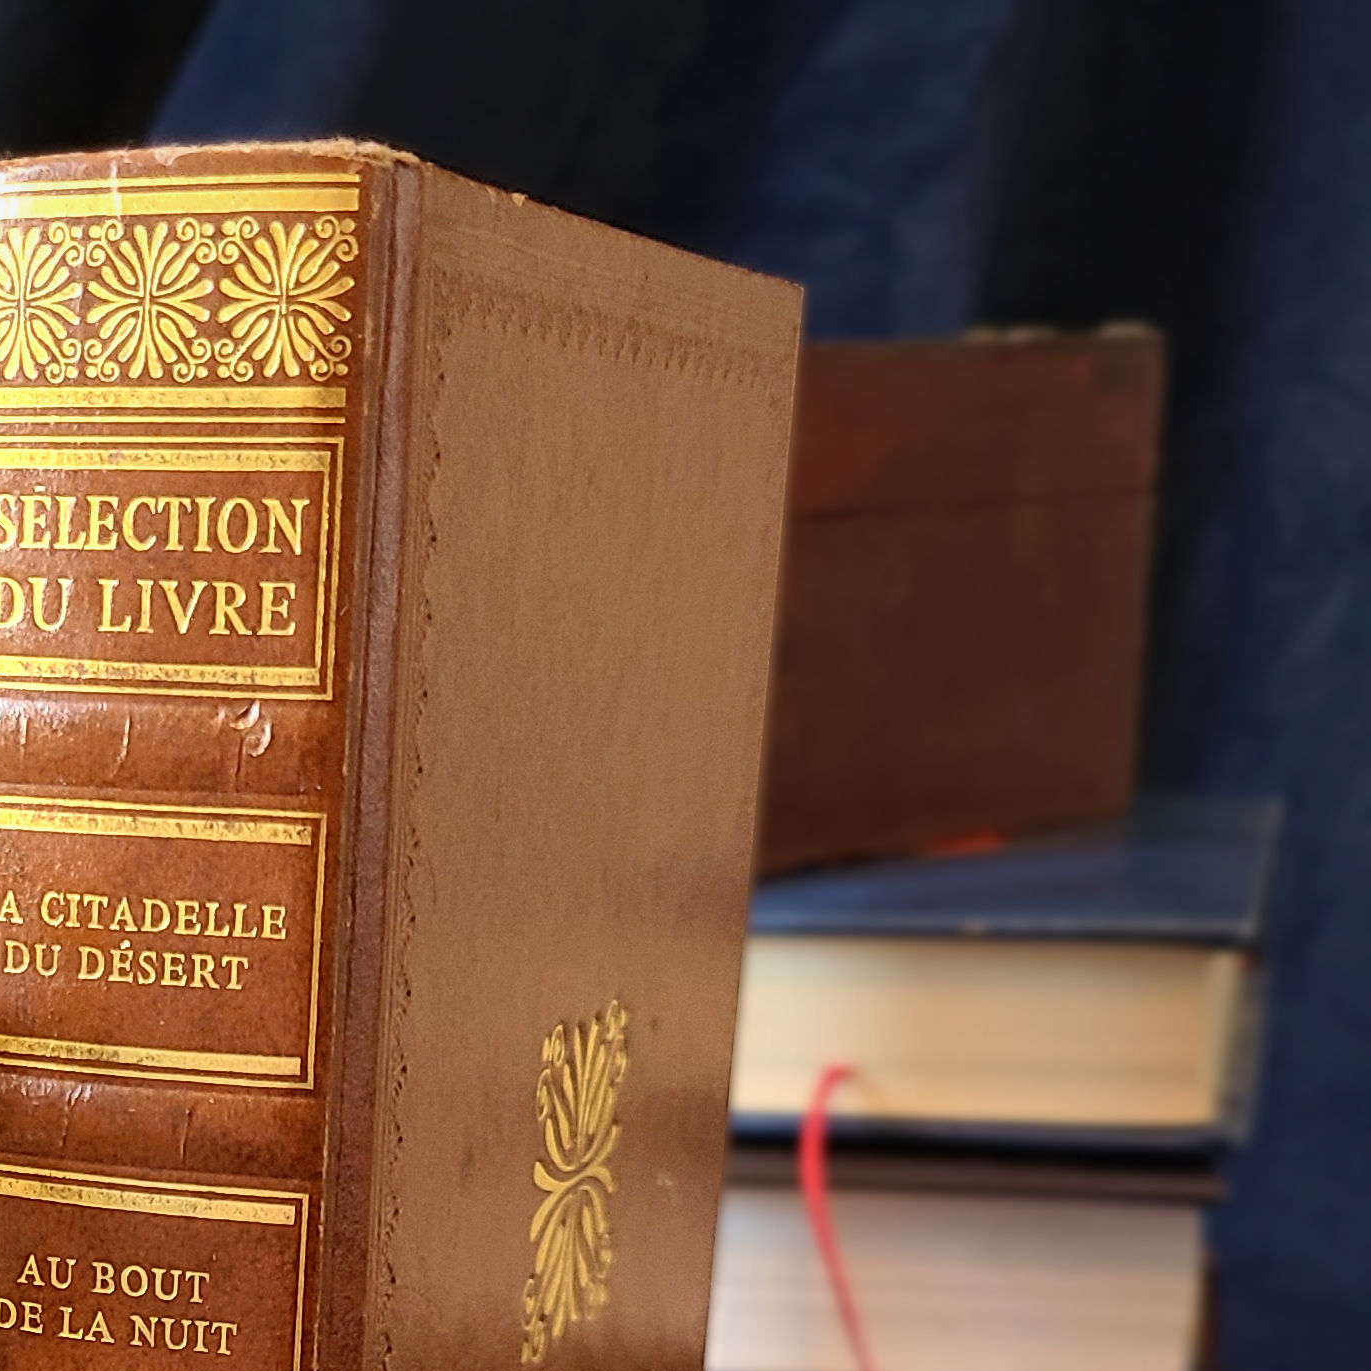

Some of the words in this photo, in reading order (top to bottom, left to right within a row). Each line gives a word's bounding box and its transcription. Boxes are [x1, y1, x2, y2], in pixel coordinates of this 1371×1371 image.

[97, 578, 297, 637] LIVRE
[40, 891, 288, 941] CITADELLE
[2, 940, 62, 977] DU
[77, 940, 250, 990] DÉSERT
[16, 1254, 77, 1290] AU
[91, 1261, 211, 1304] BOUT
[58, 1306, 116, 1344] LA
[129, 1314, 238, 1356] NUIT
